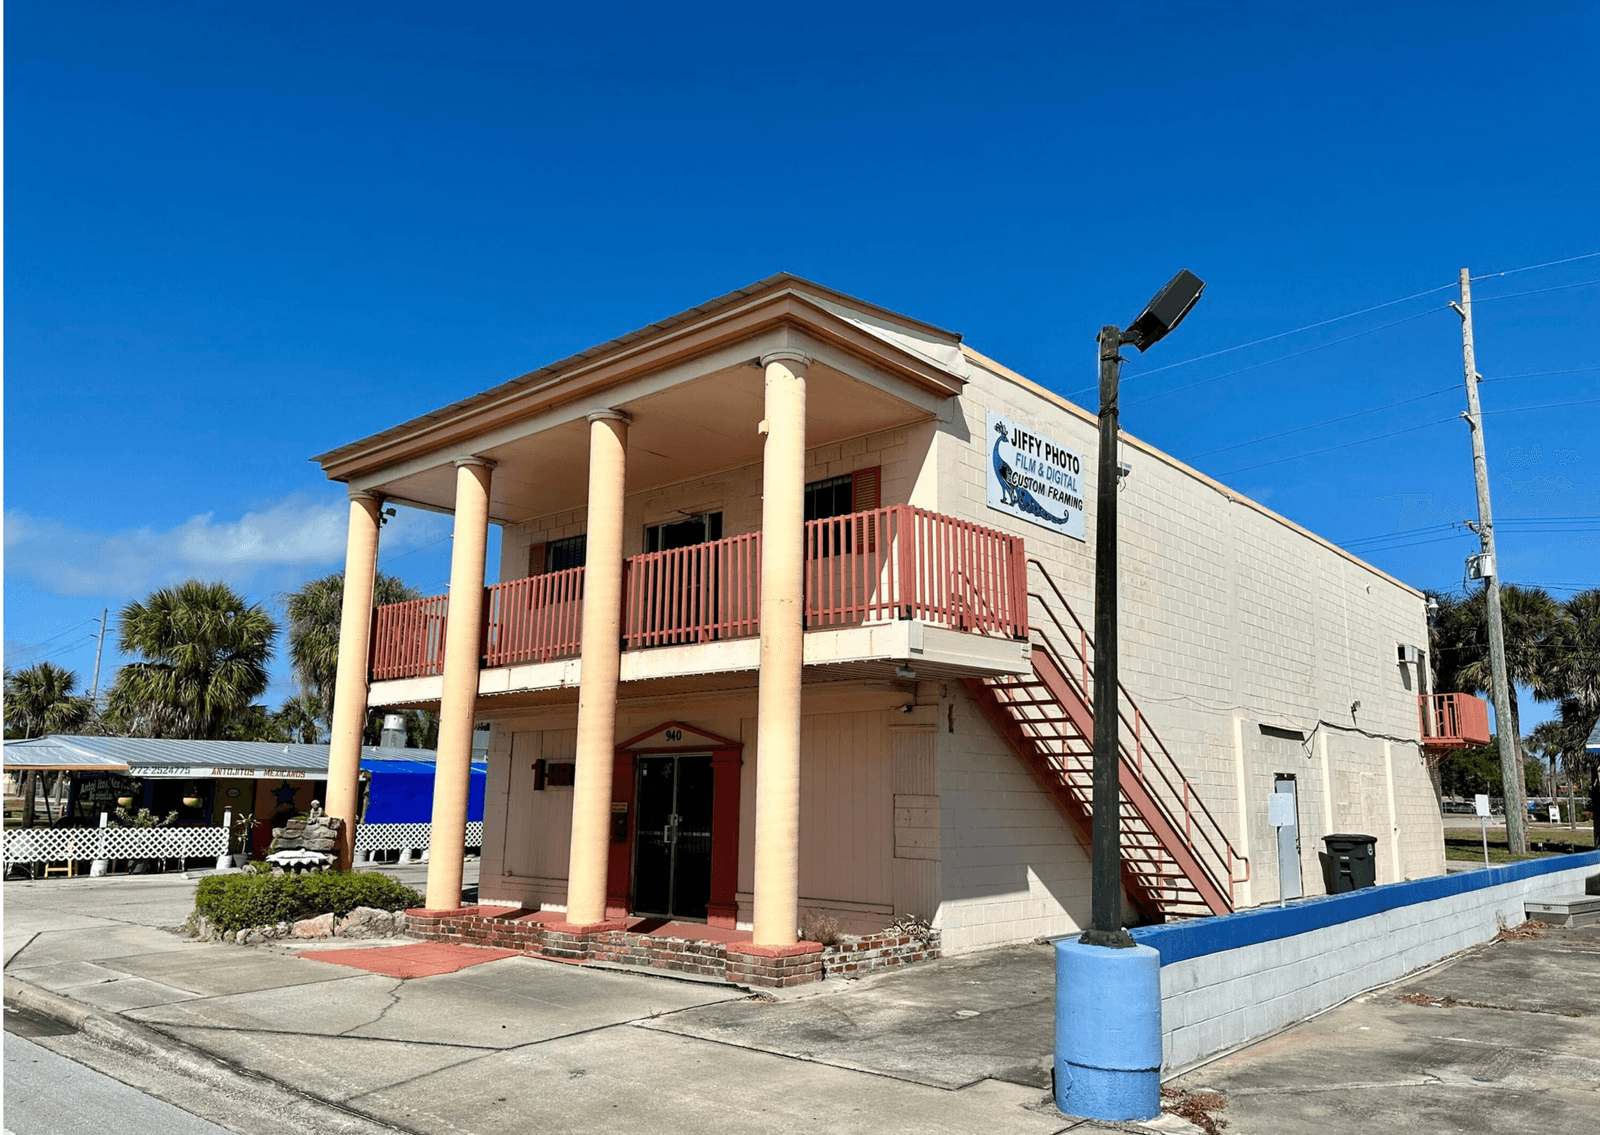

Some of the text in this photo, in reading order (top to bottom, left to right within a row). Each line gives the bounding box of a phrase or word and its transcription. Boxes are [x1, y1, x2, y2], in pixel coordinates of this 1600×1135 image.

[1011, 428, 1080, 475] JIFFY PHOTO
[1011, 472, 1083, 511] CUSTOM FRAMING
[1015, 452, 1078, 493] FILM & DIGITAL
[665, 729, 682, 742] 940
[211, 767, 306, 778] ANTOJITOS MEXICANOS
